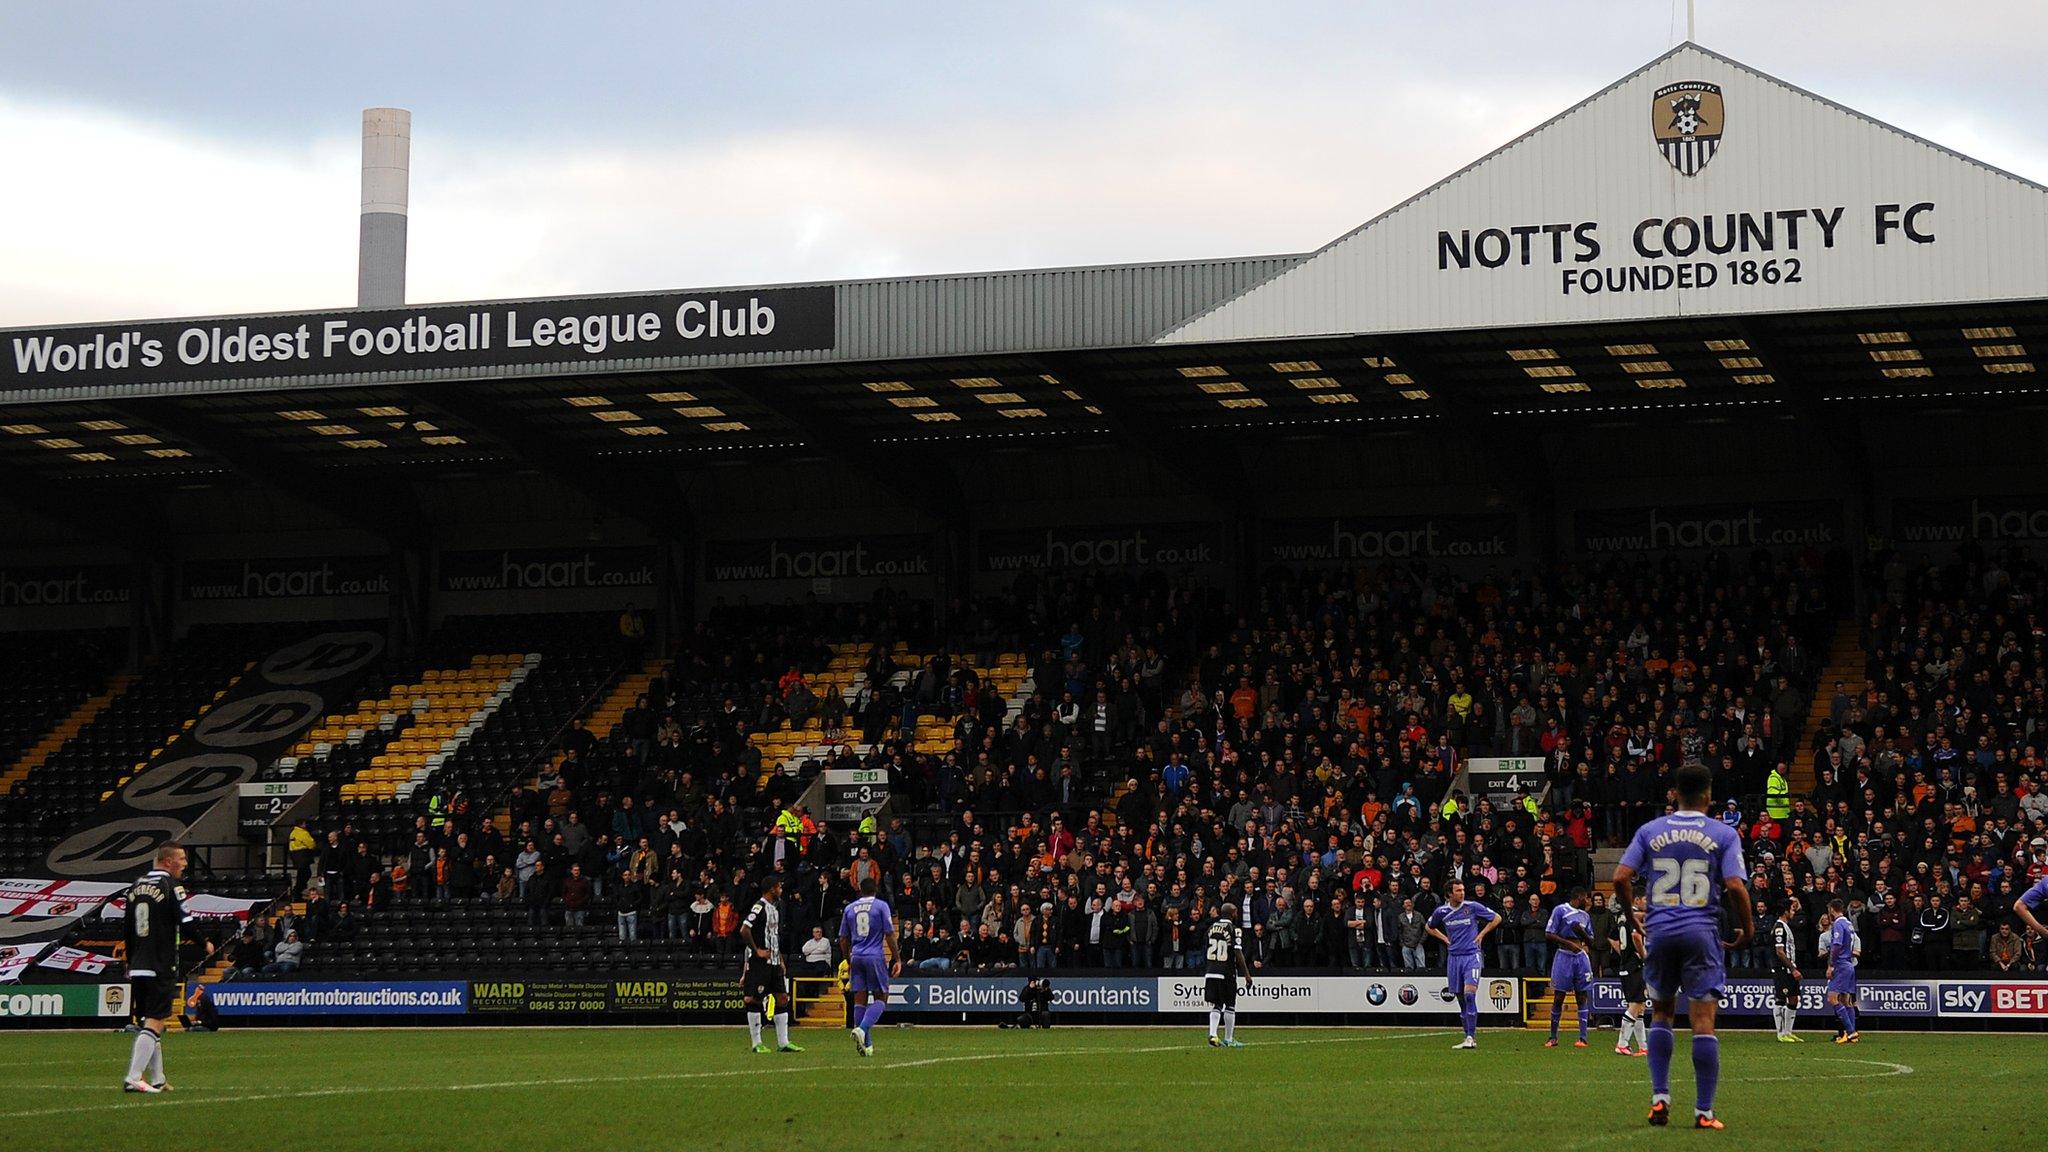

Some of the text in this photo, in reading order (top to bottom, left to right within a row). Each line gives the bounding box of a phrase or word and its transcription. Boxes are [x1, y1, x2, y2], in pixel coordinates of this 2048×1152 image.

[1438, 202, 1935, 270] NOTTS COUNTY FC
[1562, 257, 1801, 295] FOUNDED 1862
[13, 298, 776, 374] World's Oldest Football League Club
[715, 540, 928, 581] www.haart.co.uk
[448, 551, 653, 591] www.haart.co.uk
[1506, 774, 1519, 792] 4
[843, 791, 858, 799] EXIT
[860, 785, 871, 803] 3
[270, 797, 281, 814] 2
[1652, 857, 1710, 908] 26
[856, 911, 870, 936] 8
[1207, 938, 1228, 962] 20
[213, 987, 462, 1006] www.newarkmotorauctions.co.uk
[473, 983, 525, 998] WARD
[615, 982, 668, 997] WARD
[929, 983, 1150, 1005] Baldwins countants
[1237, 984, 1311, 999] ottingham
[1860, 987, 1926, 1002] Pinnacle
[1944, 985, 2048, 1012] sky BET
[529, 1001, 555, 1011] 0845
[558, 1001, 577, 1010] 337
[579, 1000, 605, 1010] 0000
[673, 999, 745, 1010] 0845 337 000
[1879, 1001, 1927, 1011] .eu.com
